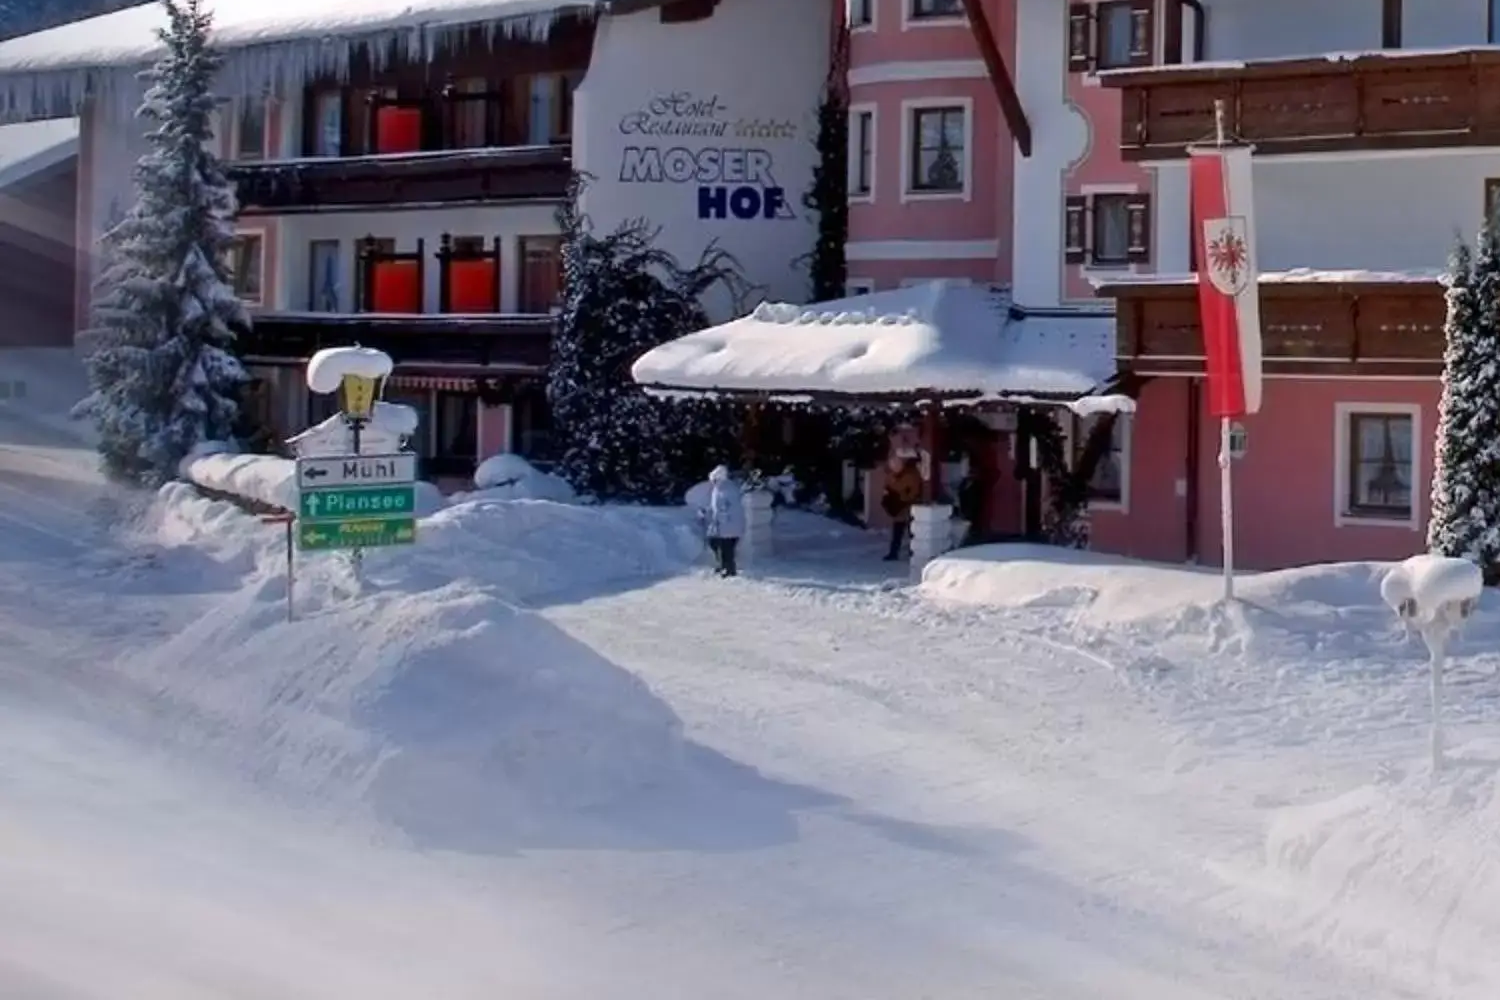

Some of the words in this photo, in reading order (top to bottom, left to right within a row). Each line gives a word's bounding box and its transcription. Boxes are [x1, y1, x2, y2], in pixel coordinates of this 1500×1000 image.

[619, 110, 732, 138] Restaurant
[619, 147, 778, 190] MOSER
[698, 186, 785, 219] HOF
